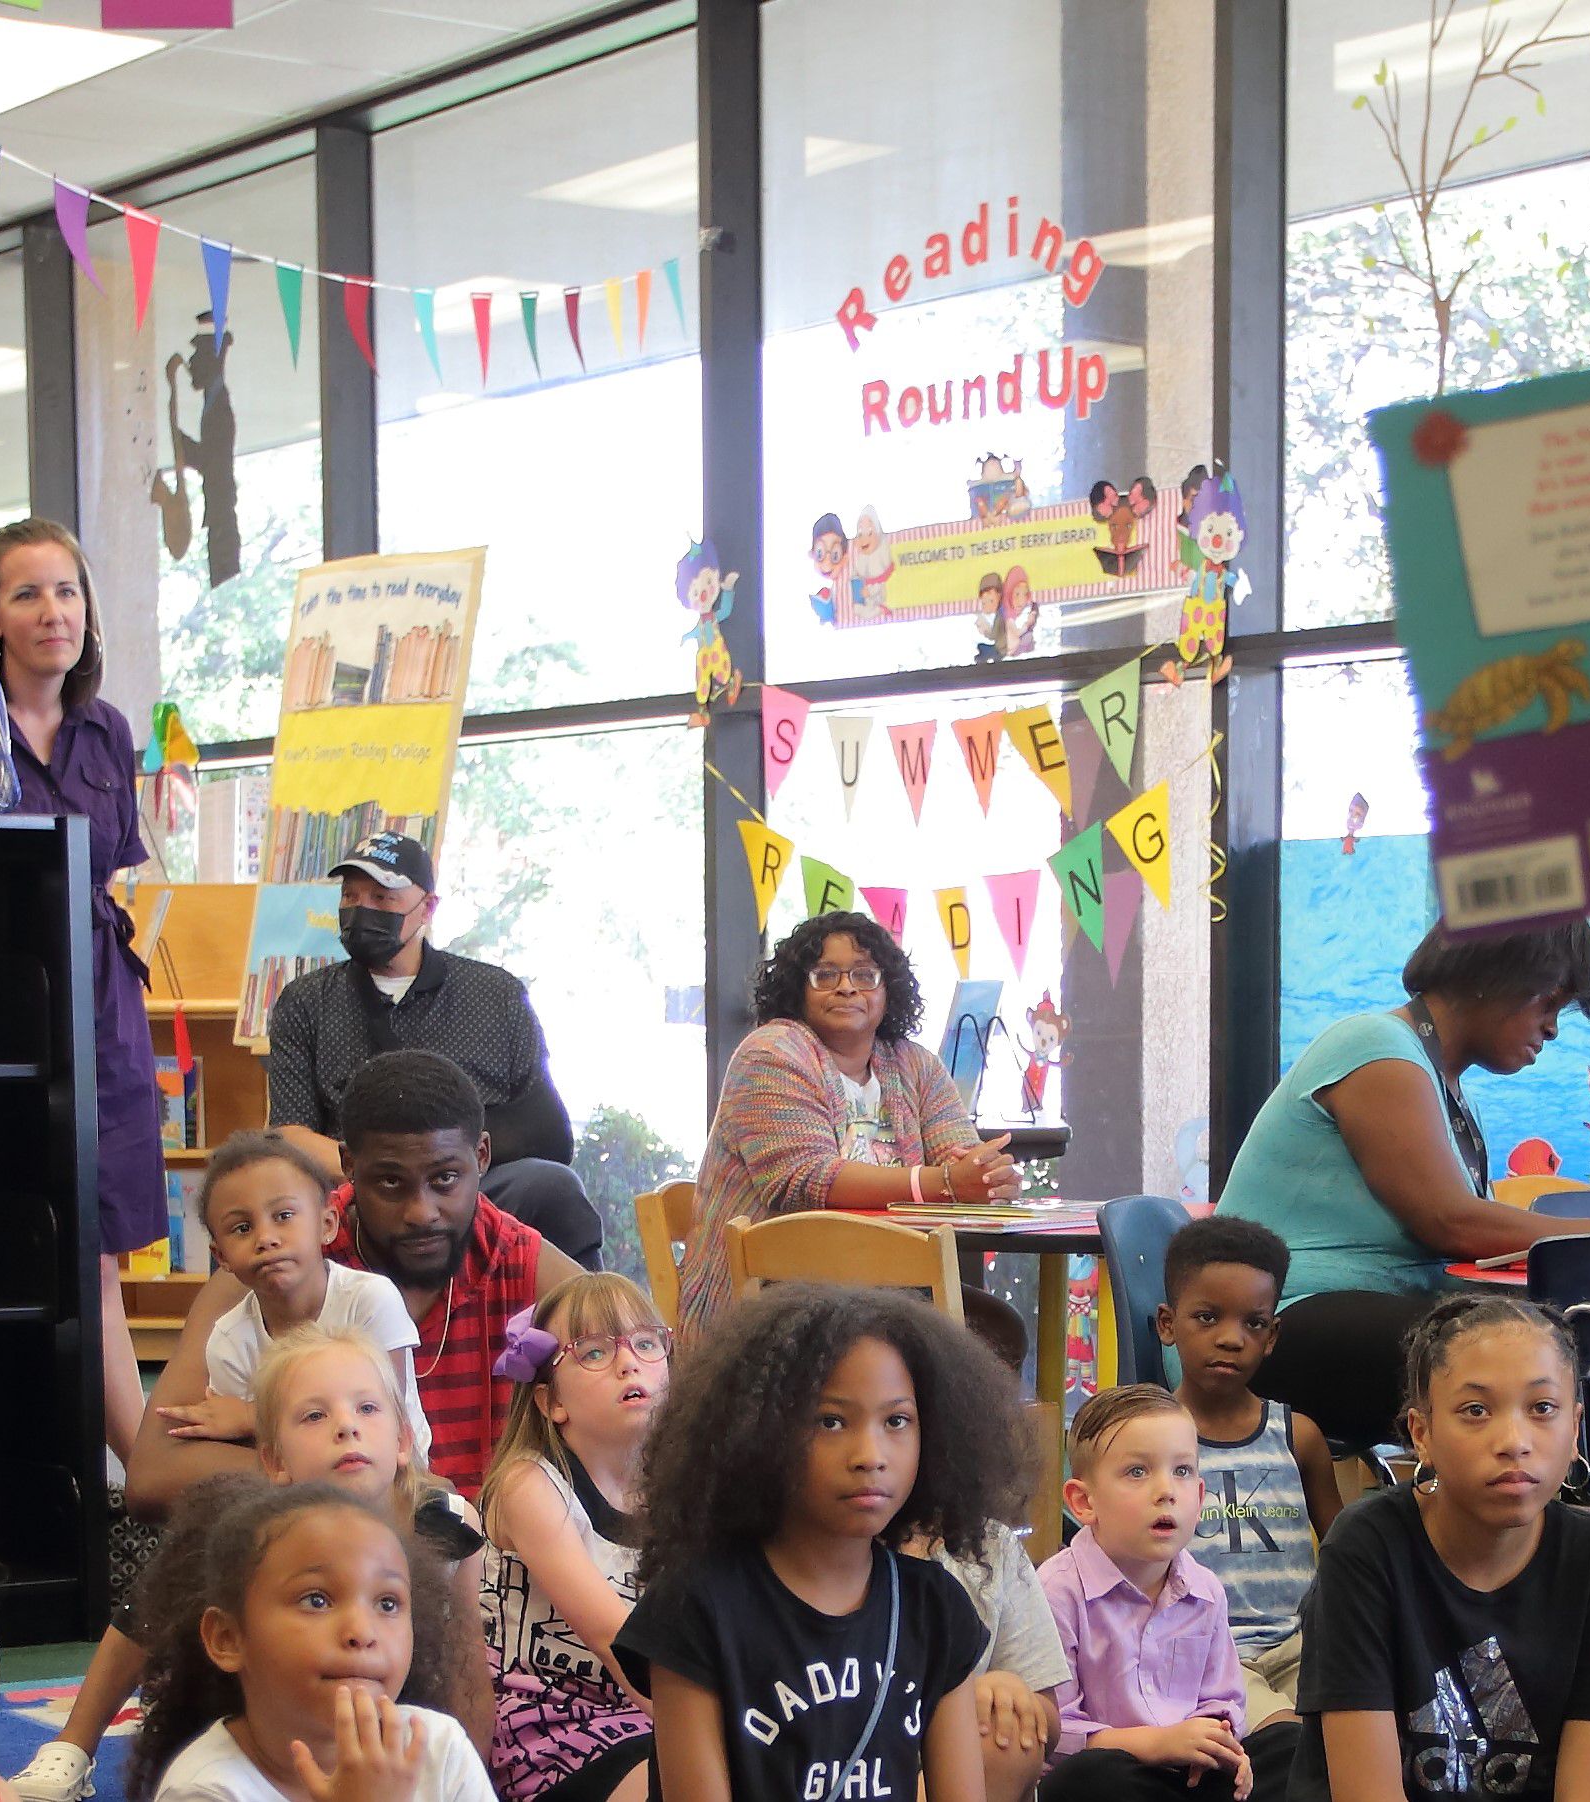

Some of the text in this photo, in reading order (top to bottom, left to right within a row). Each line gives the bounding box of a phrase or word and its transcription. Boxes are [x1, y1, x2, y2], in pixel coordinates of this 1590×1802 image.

[836, 196, 1106, 353] Reading
[862, 346, 1109, 437] Round Up
[898, 527, 1098, 566] WELCOME TO THE EAST BERRY LIBRARY
[770, 690, 1137, 788] SUMMER
[760, 812, 1166, 951] READING
[1222, 1503, 1259, 1519] Klein
[1262, 1506, 1300, 1519] Jeans
